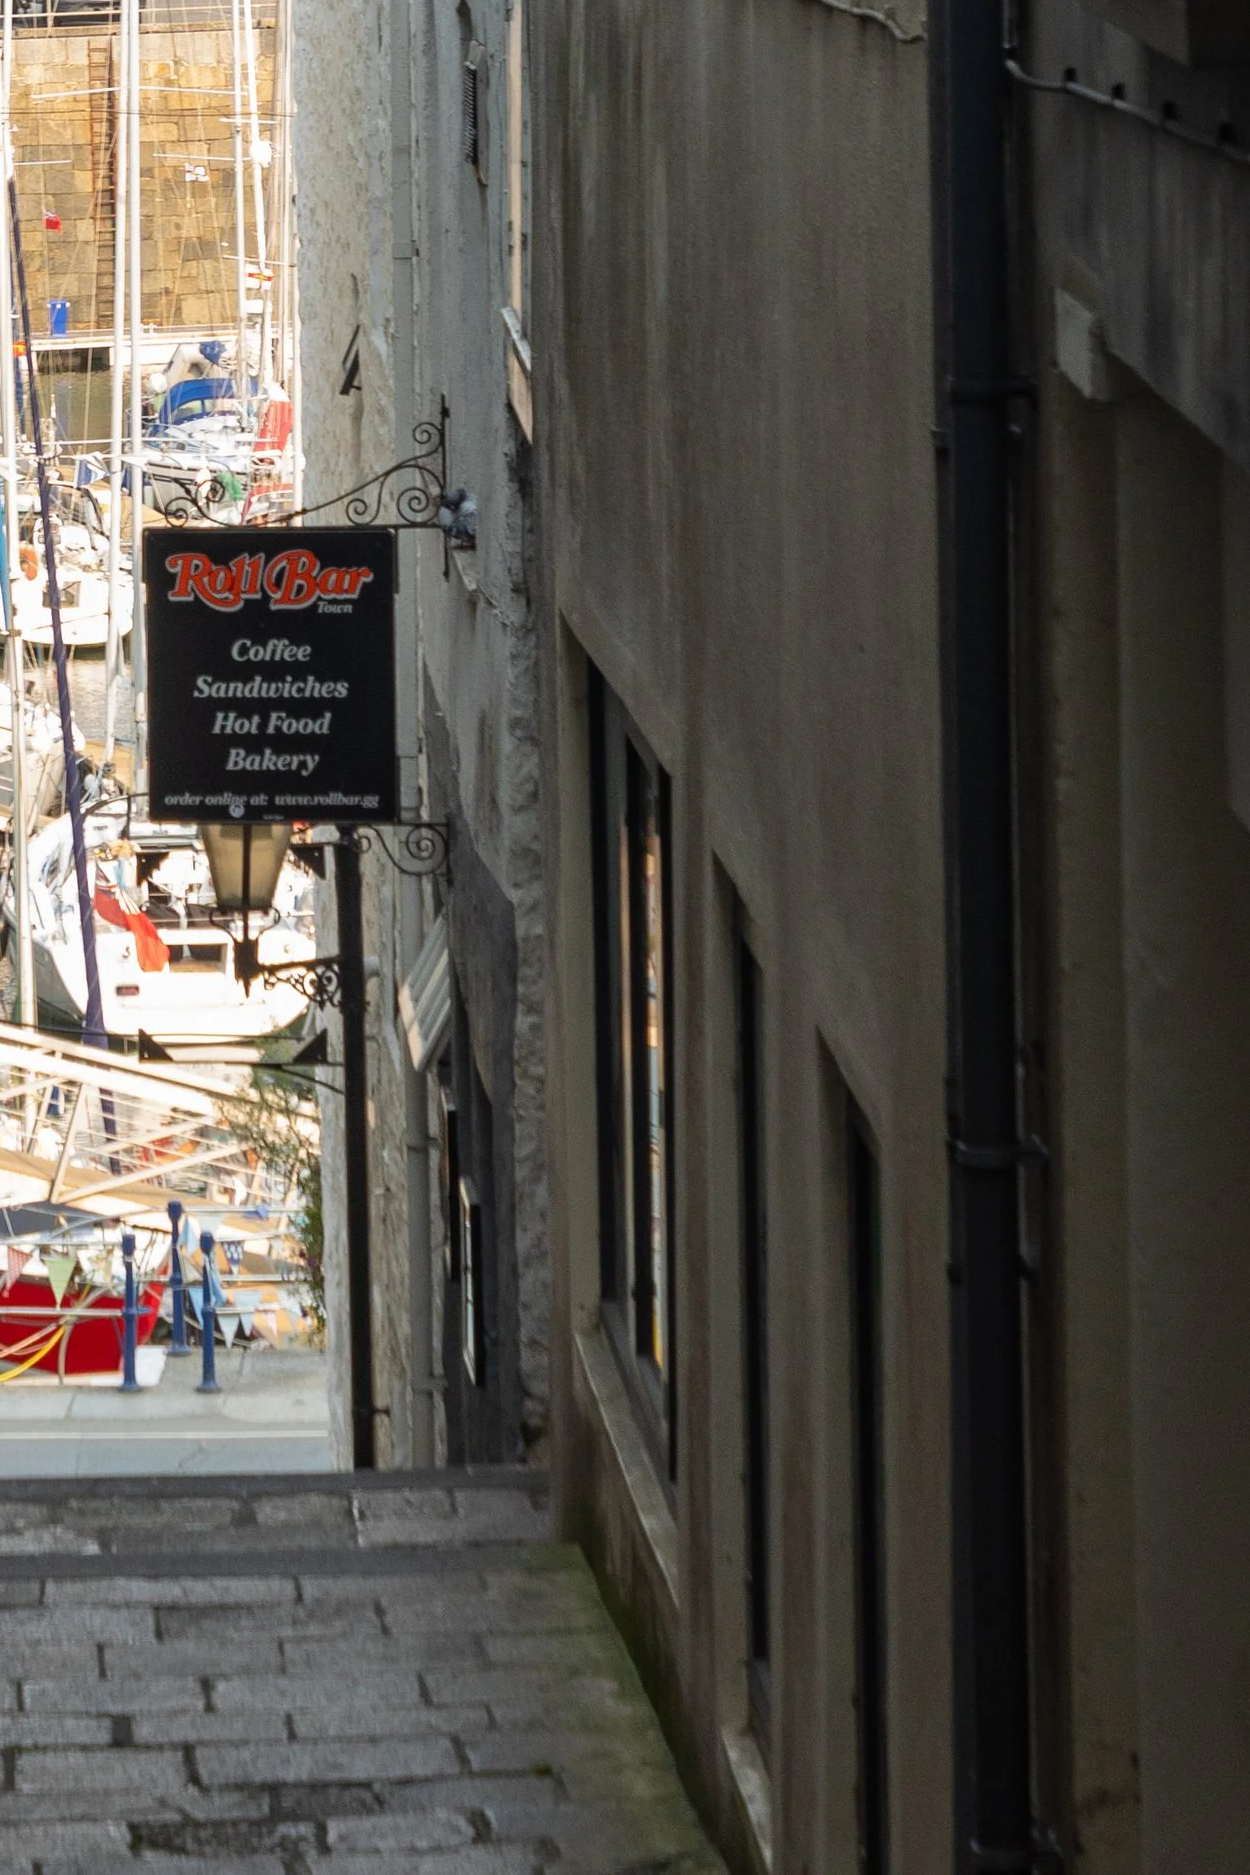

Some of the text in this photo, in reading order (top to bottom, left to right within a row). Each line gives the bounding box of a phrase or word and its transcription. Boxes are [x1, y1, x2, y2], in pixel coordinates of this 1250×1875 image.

[166, 549, 374, 612] Roll Bar
[317, 600, 353, 614] Town
[231, 638, 312, 662] Coffee
[193, 675, 349, 699] Sandwiches
[211, 712, 332, 735] Hot Food
[225, 748, 320, 776] Bakery
[164, 792, 204, 806] order
[205, 792, 248, 806] online
[274, 791, 380, 809] www.rollbar.gg
